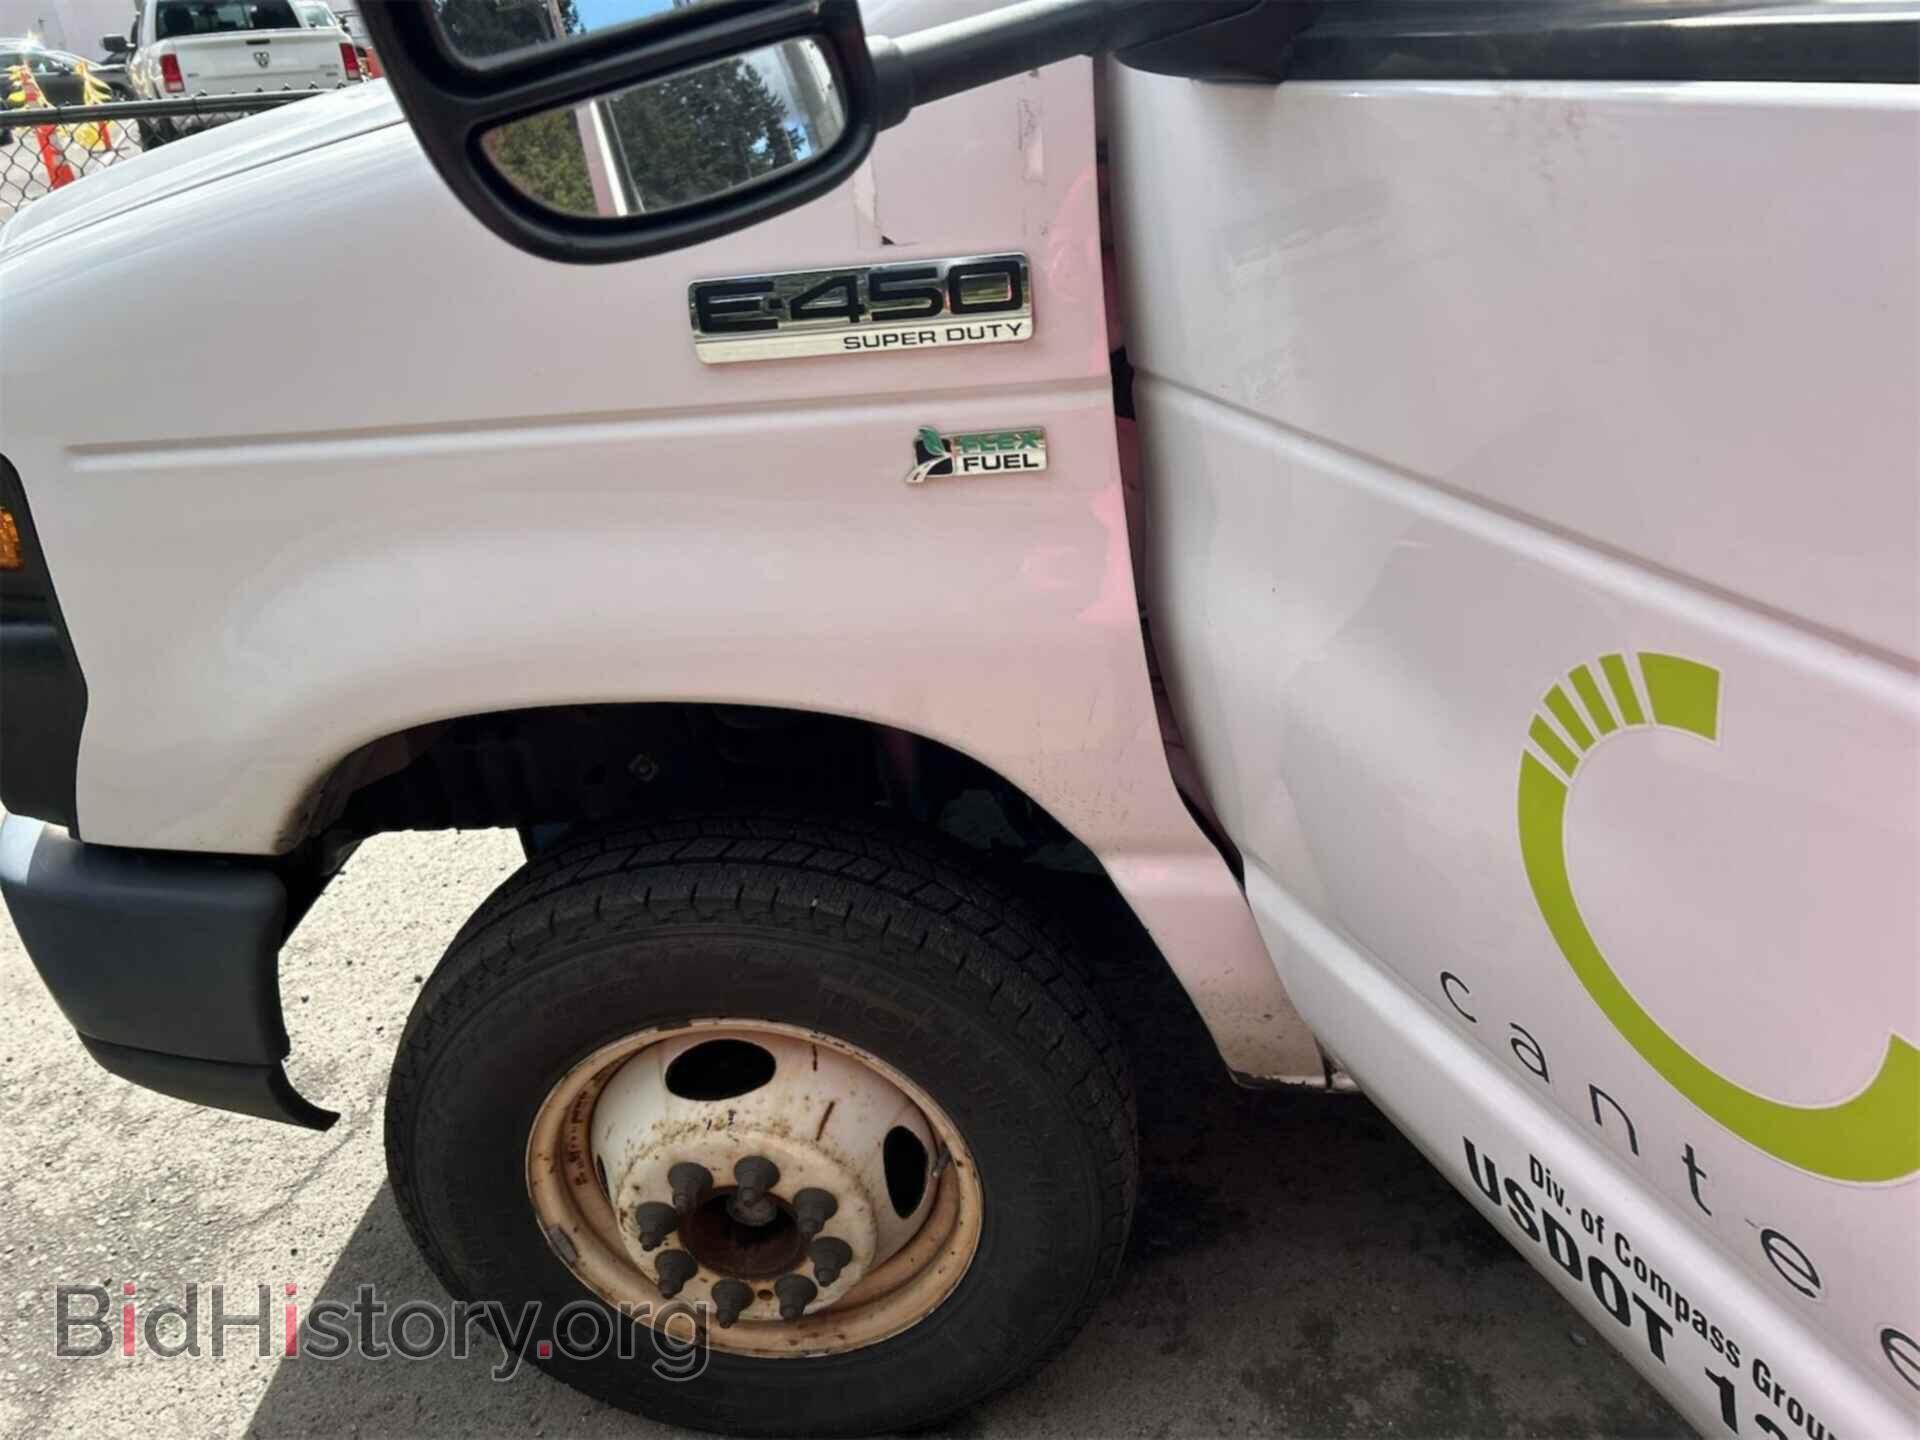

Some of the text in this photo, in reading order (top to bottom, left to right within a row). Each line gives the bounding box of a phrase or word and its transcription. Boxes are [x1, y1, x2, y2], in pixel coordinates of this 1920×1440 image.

[842, 322, 1023, 351] SUPER DUTY
[959, 430, 1039, 453] FLEX
[962, 453, 1039, 472] FUEL
[1462, 1135, 1790, 1440] USDOT 1
[1528, 1153, 1840, 1440] Div. of Compass Grou
